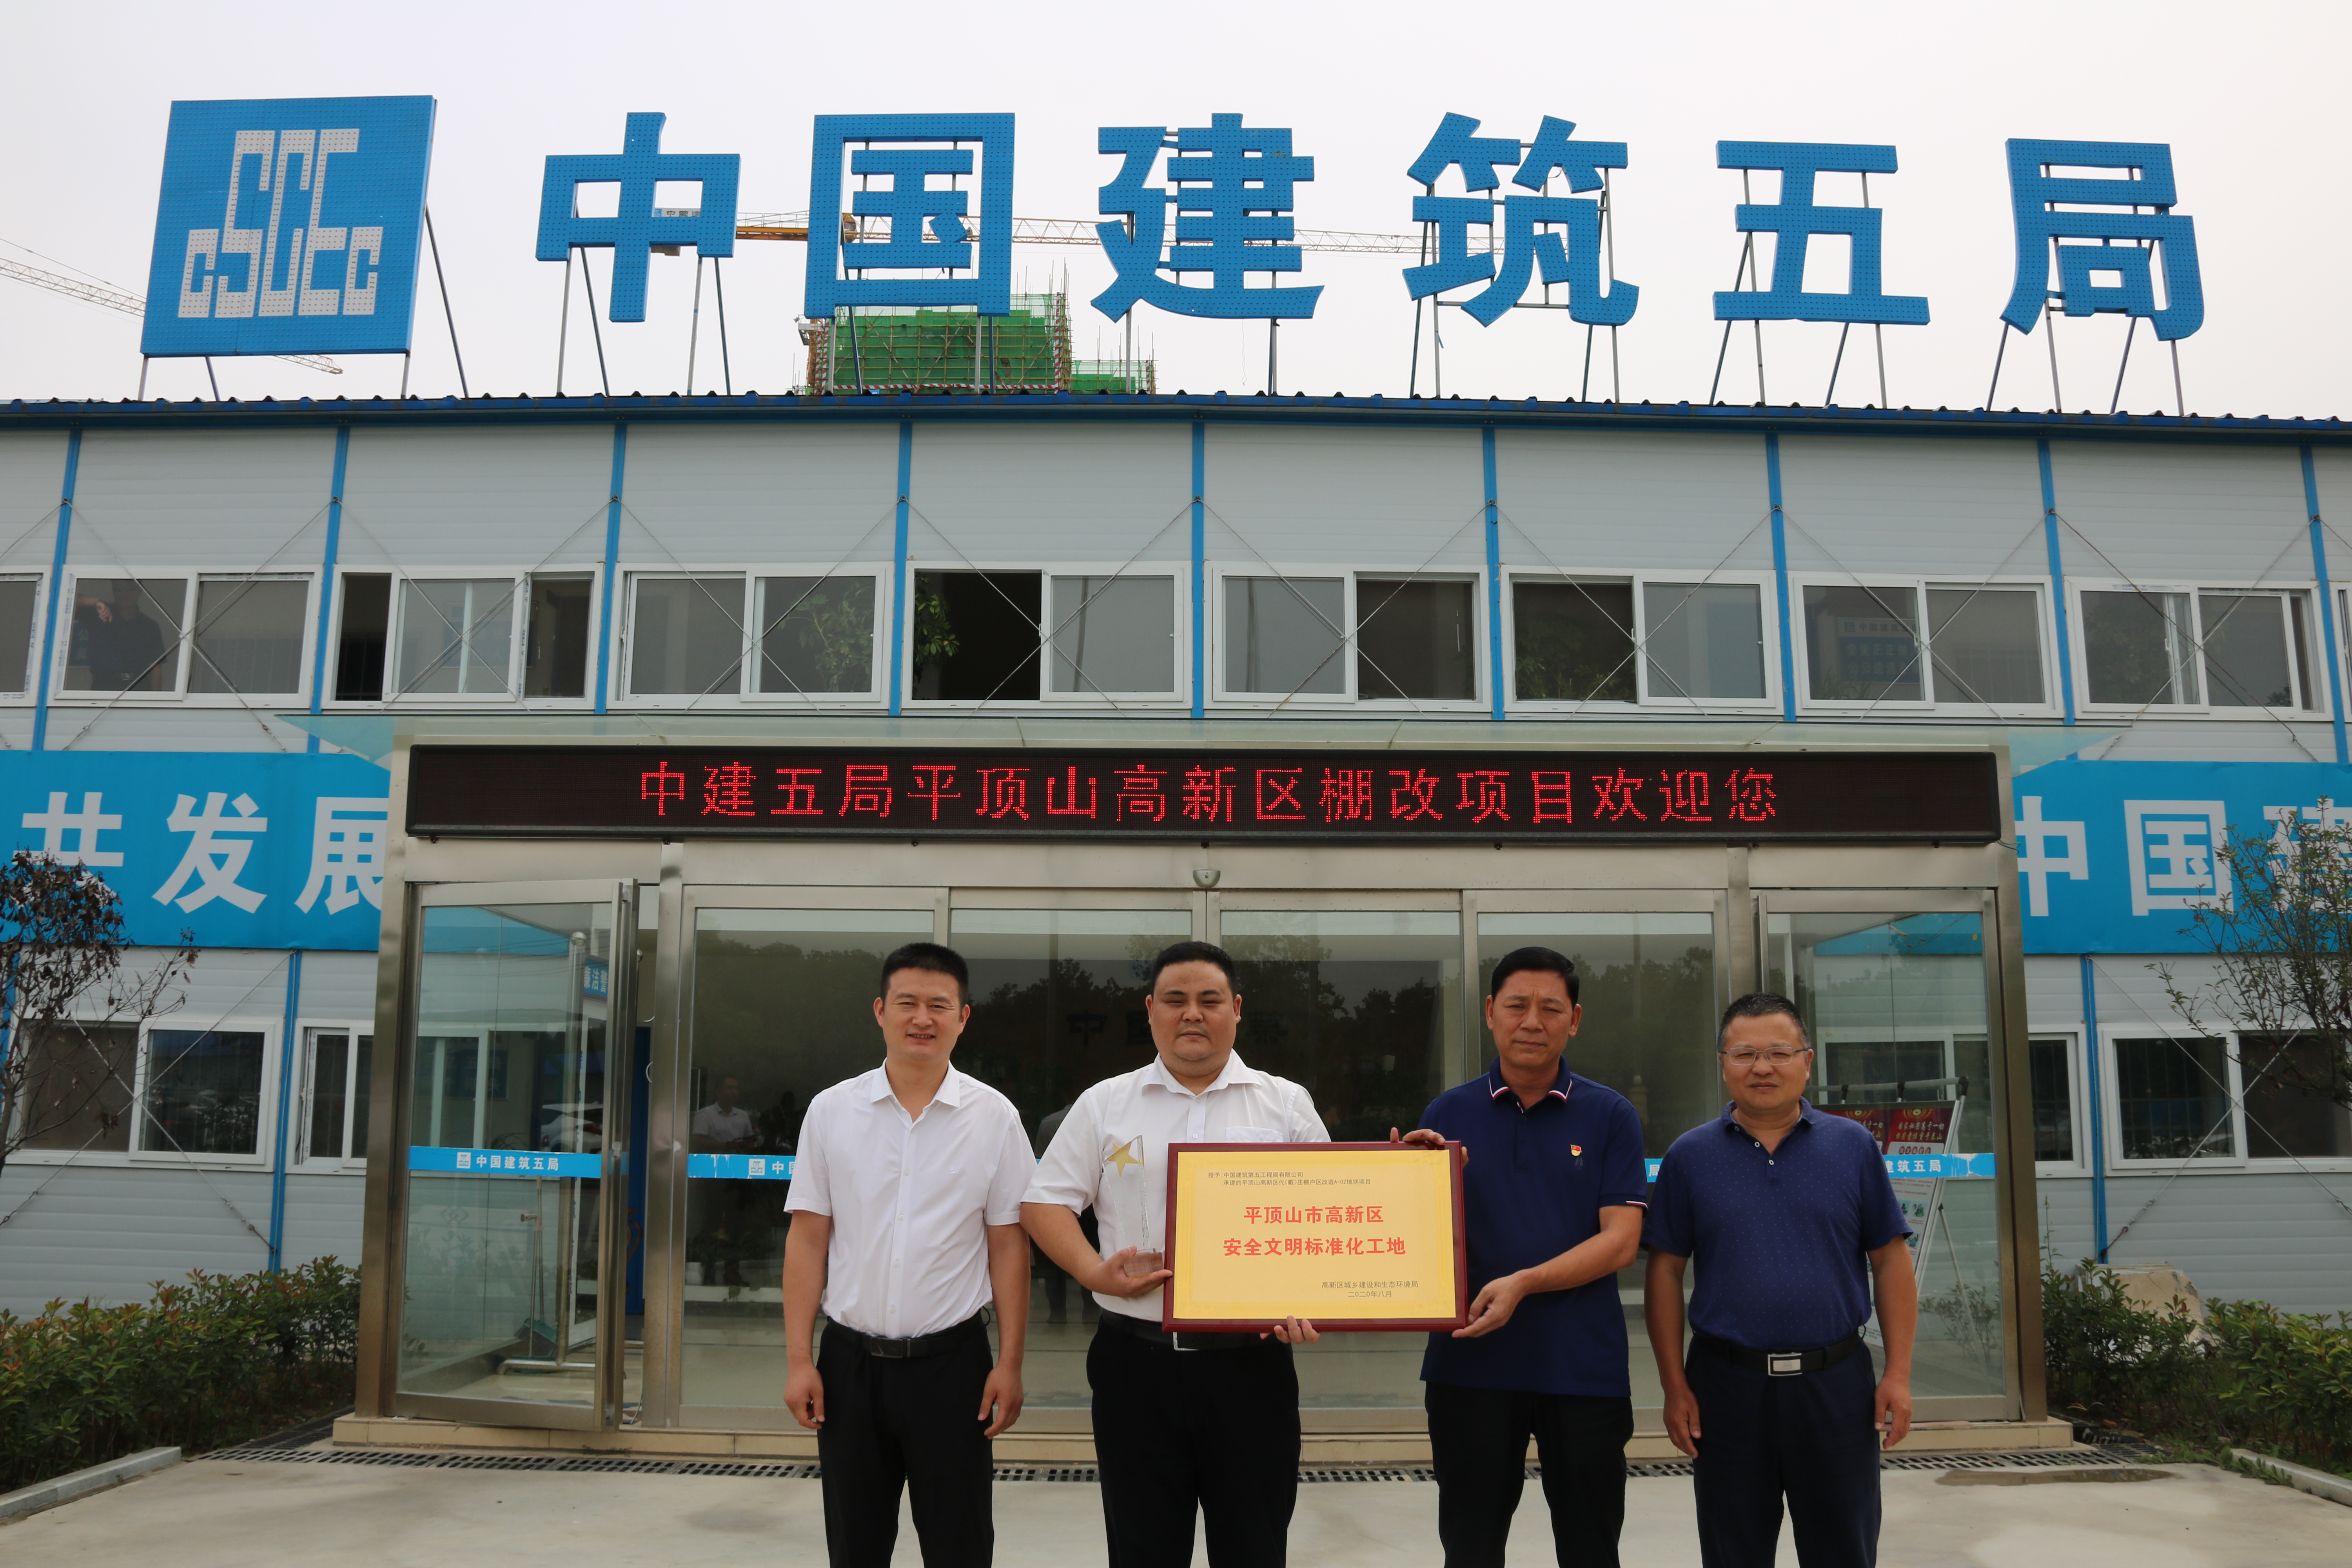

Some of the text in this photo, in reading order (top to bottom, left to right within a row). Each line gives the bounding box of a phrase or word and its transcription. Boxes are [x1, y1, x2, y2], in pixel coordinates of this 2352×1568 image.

[536, 112, 2204, 341] 中国建筑五局
[641, 761, 1777, 824] 中建五局平顶山高新区棚改项目欢迎您
[476, 1154, 559, 1171] 中国建筑五局
[1244, 1205, 1384, 1224] 平顶山市高新区
[1223, 1237, 1406, 1256] 安全文明标准化工地
